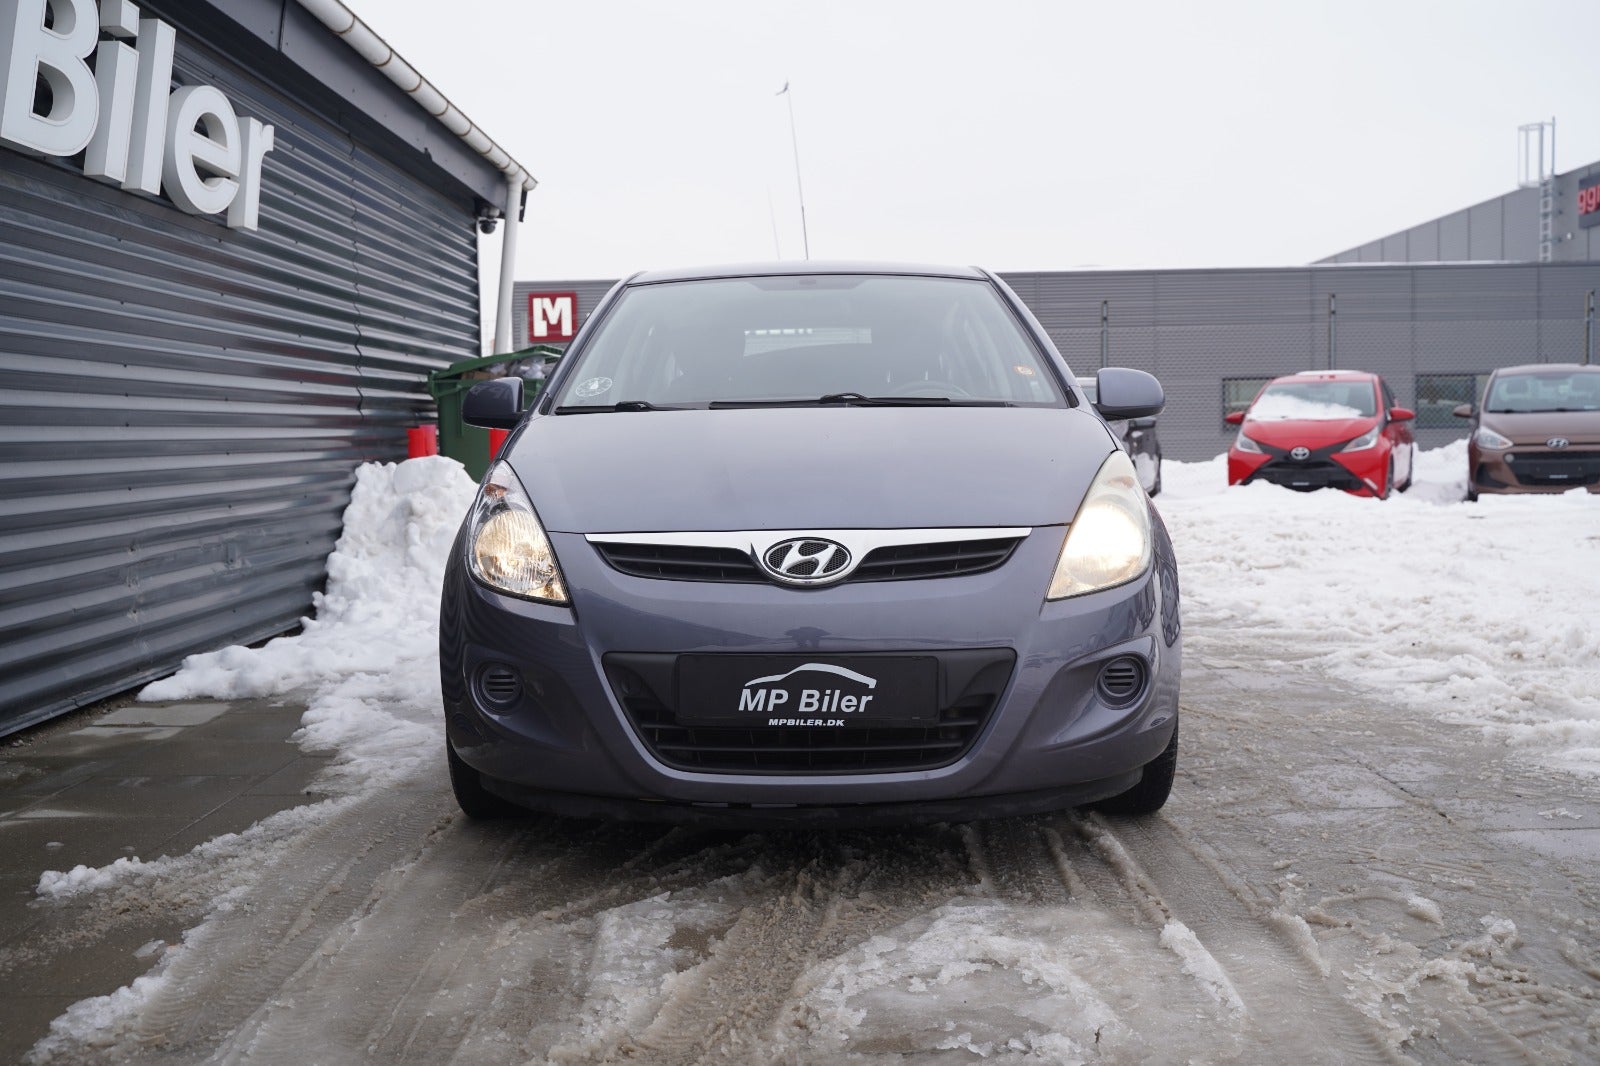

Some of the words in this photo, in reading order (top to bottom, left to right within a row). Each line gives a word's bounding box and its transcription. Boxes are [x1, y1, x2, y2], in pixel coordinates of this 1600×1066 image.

[0, 0, 274, 231] Biler
[738, 688, 789, 711] MP
[798, 689, 873, 712] Biler
[768, 718, 845, 727] MPBILER.DK
